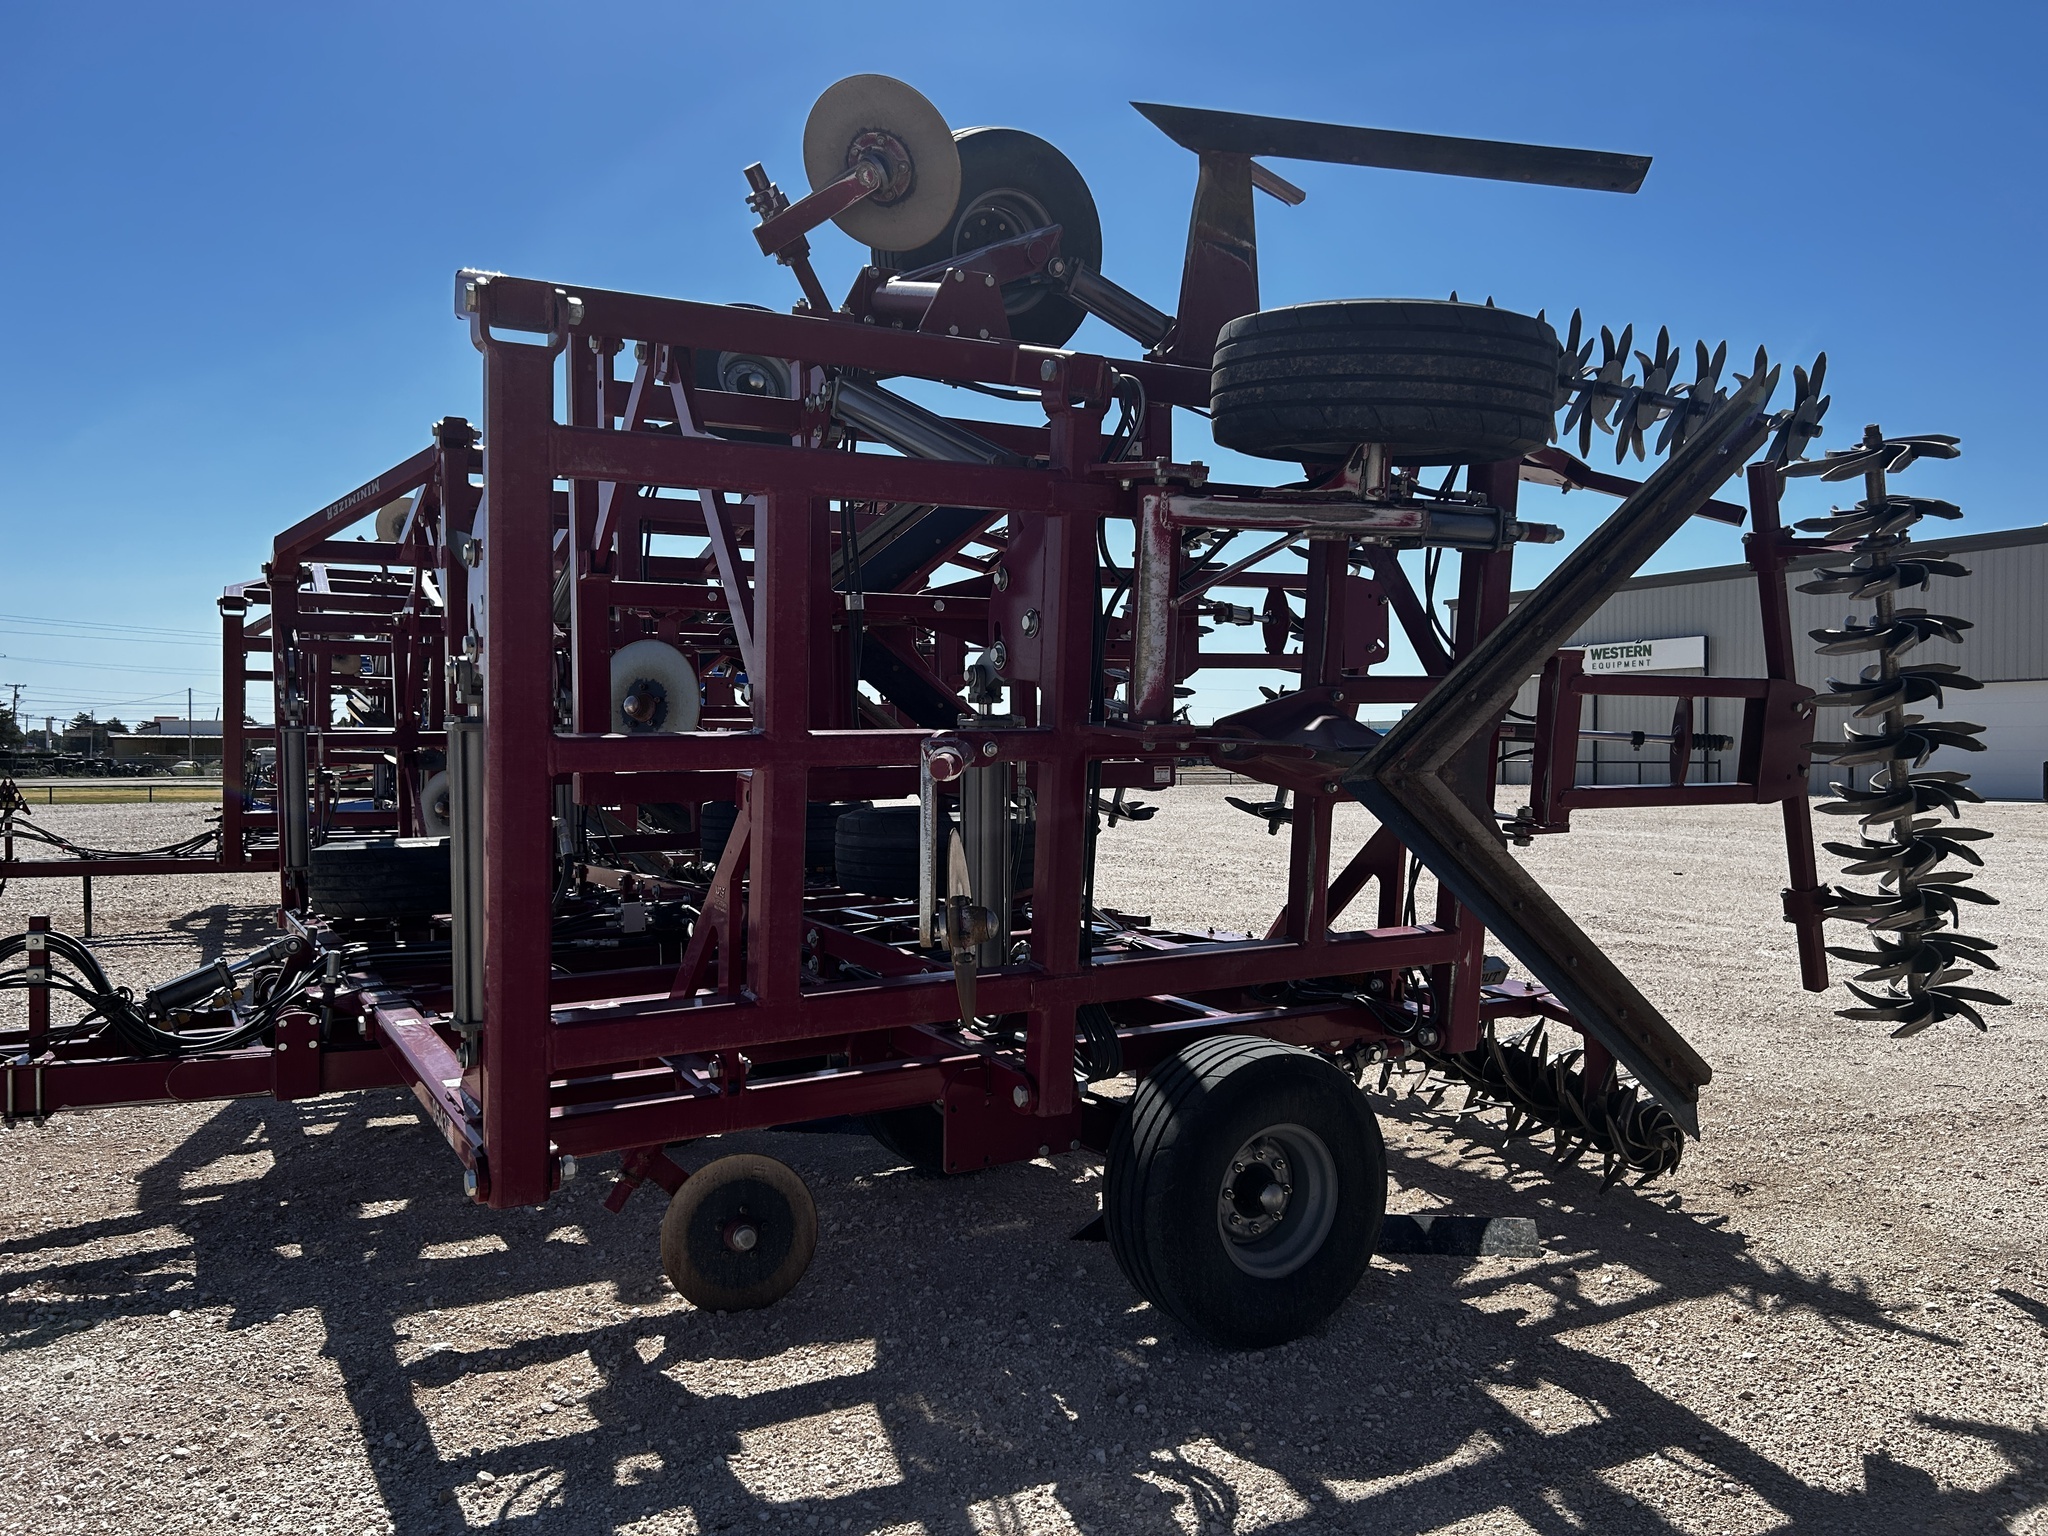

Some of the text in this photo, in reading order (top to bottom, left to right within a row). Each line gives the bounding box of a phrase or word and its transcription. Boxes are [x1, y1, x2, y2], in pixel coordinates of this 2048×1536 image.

[326, 478, 380, 521] MINIMIZER
[1590, 644, 1652, 661] WESTERN
[1592, 659, 1651, 670] EQUIPMENT
